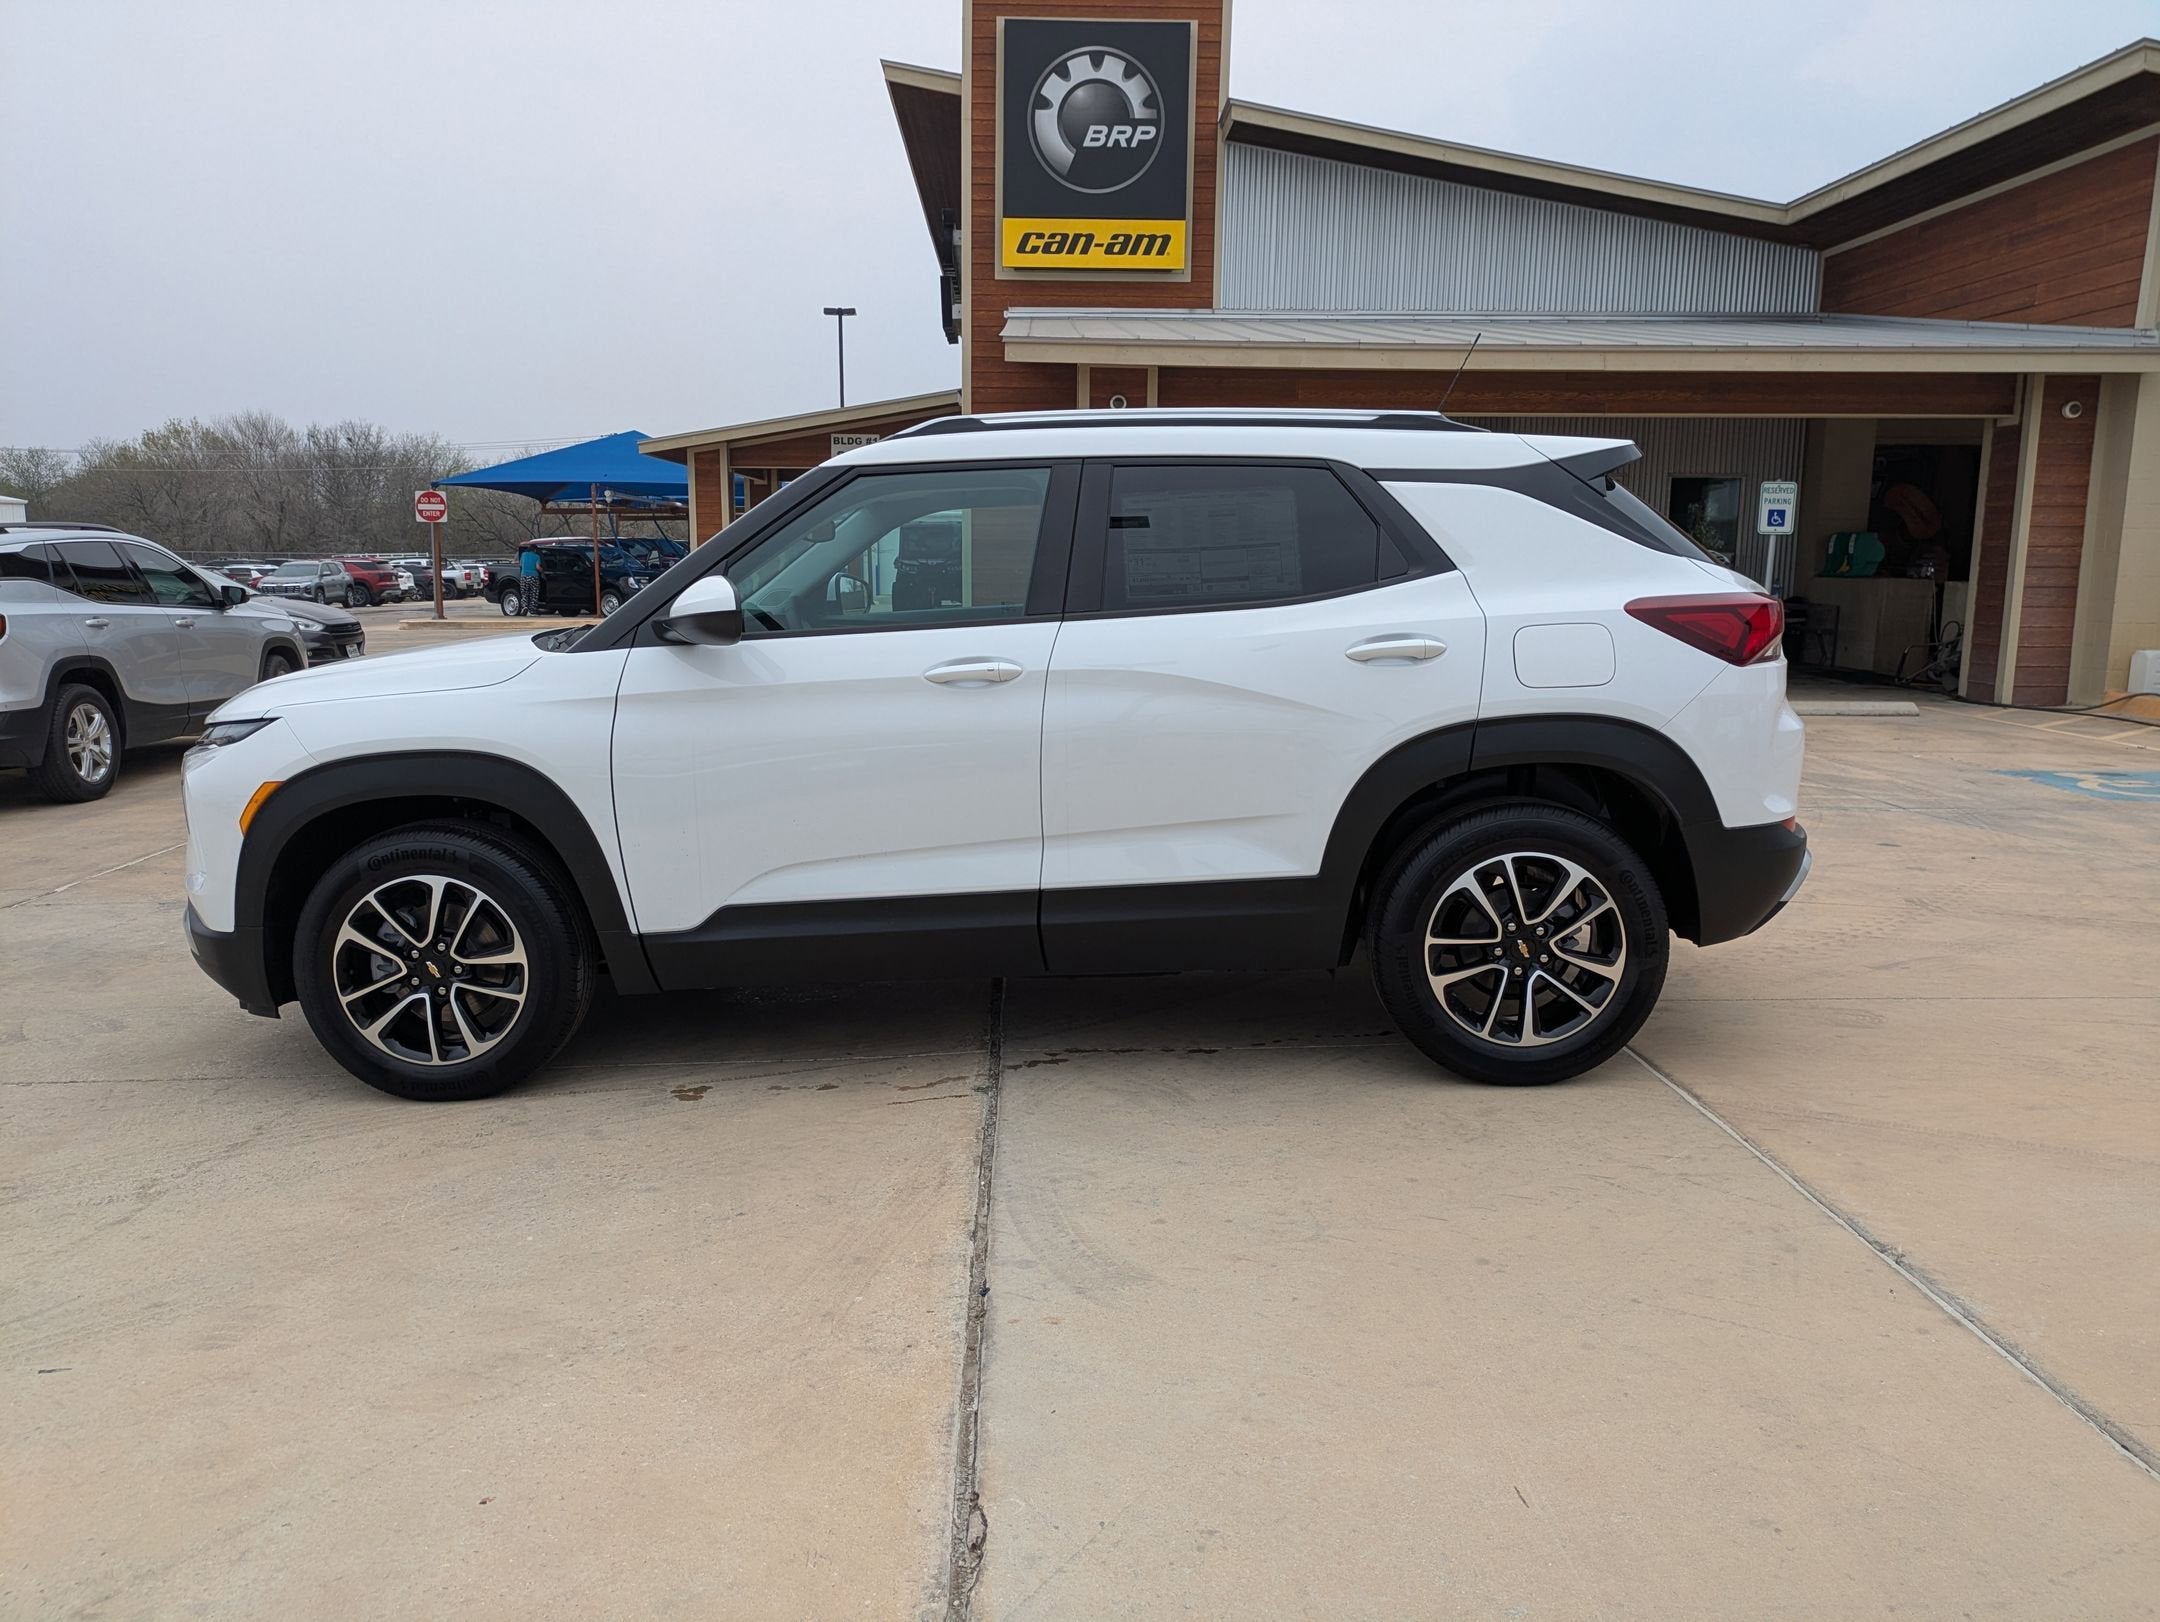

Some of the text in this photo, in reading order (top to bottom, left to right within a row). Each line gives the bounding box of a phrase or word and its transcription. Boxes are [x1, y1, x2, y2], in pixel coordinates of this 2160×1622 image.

[1083, 125, 1157, 148] BRP
[1015, 231, 1173, 256] can-am
[833, 436, 878, 445] BLDG #1
[1763, 486, 1795, 494] RESERVED
[1764, 497, 1792, 505] PARKING
